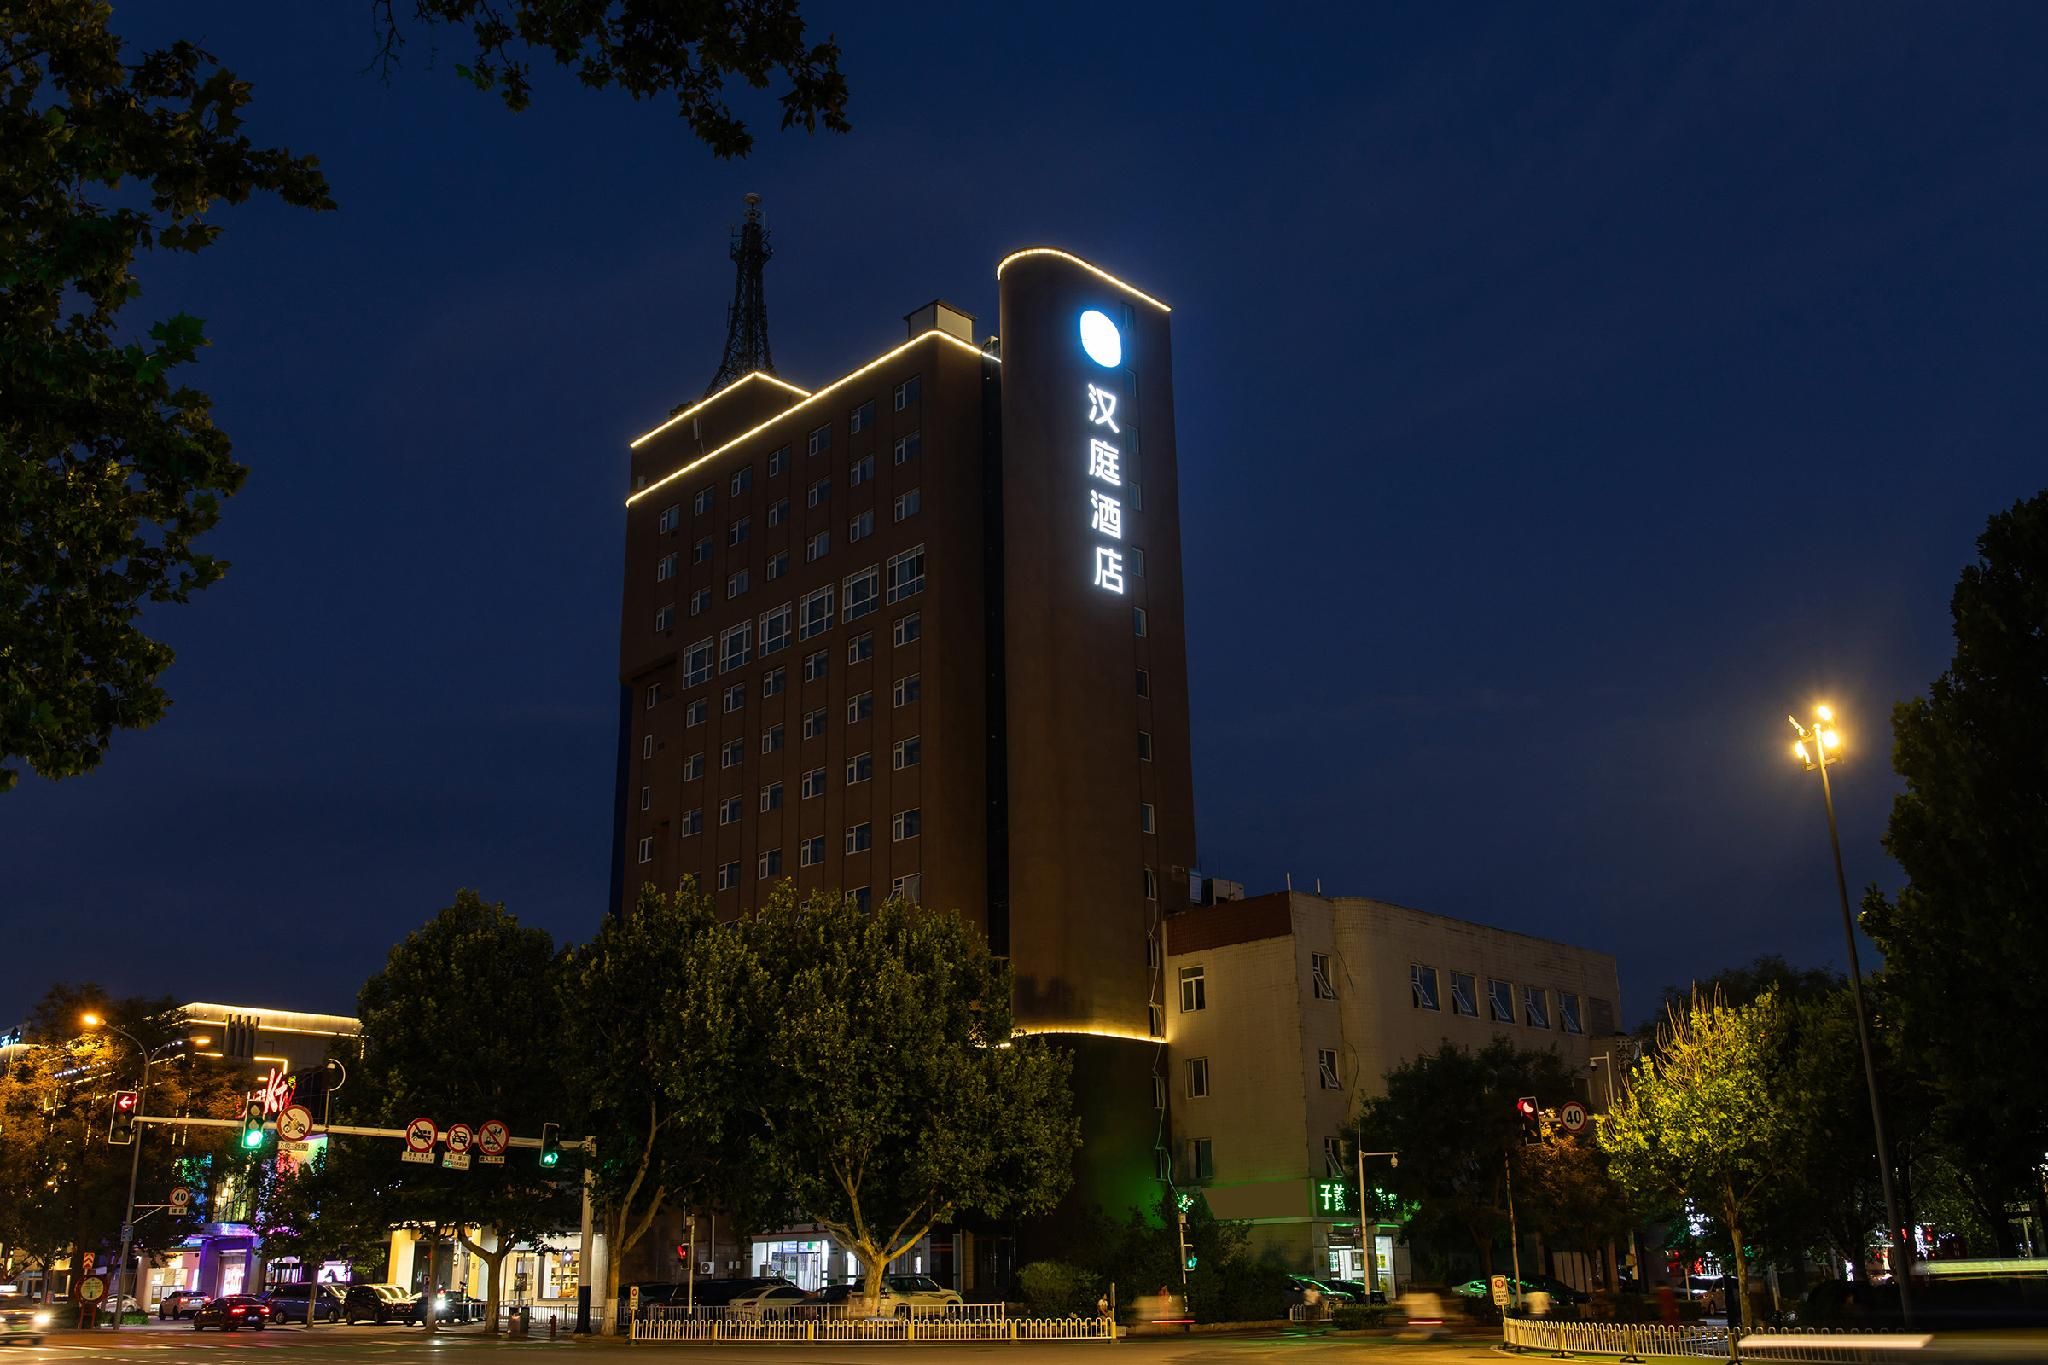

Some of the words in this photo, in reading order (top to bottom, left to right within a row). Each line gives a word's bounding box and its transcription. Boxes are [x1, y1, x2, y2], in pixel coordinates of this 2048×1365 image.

[1088, 383, 1124, 595] 汉庭酒店
[1566, 1110, 1581, 1124] 40
[174, 1192, 187, 1202] 40
